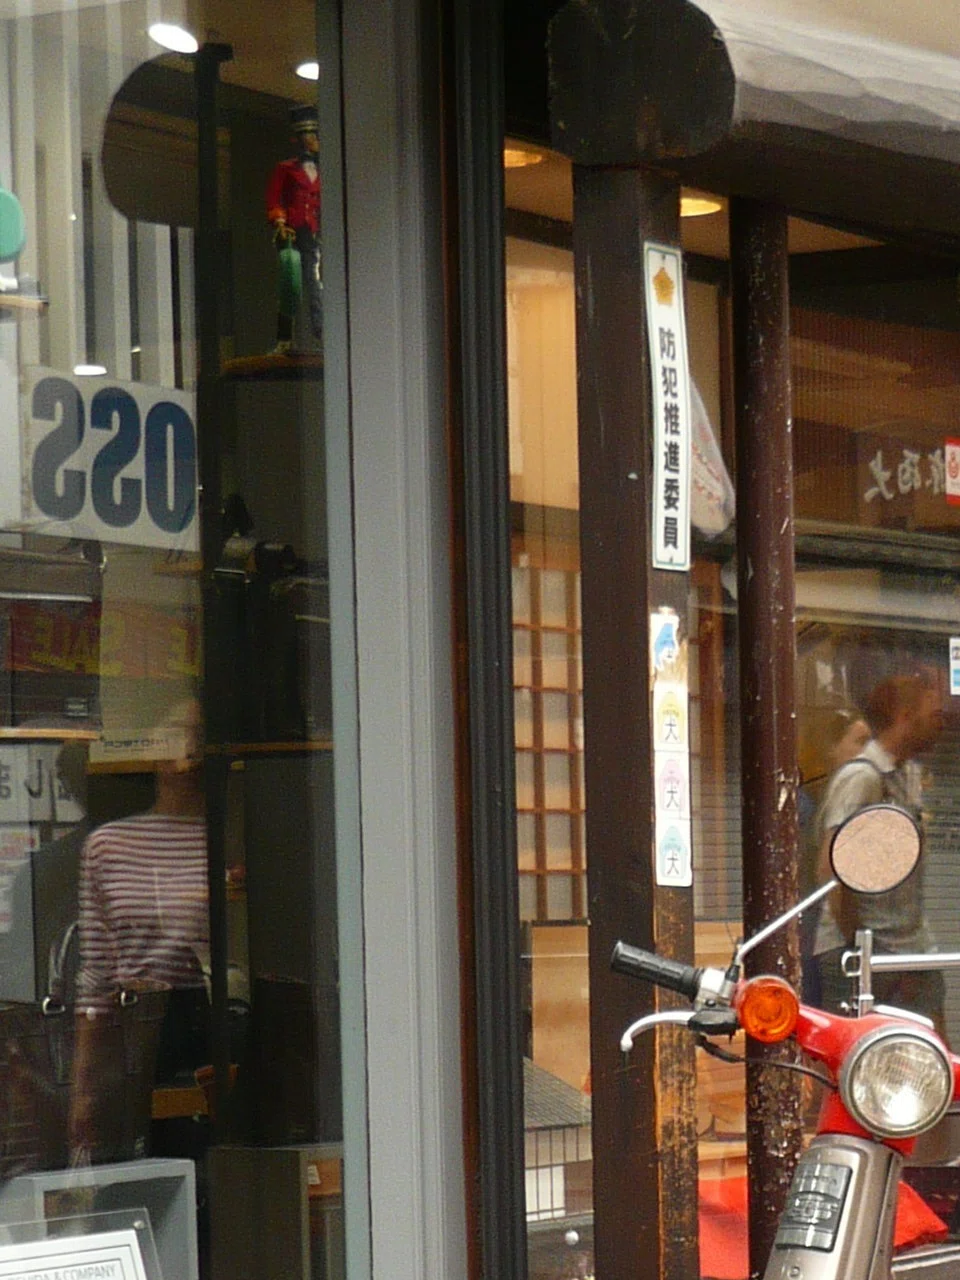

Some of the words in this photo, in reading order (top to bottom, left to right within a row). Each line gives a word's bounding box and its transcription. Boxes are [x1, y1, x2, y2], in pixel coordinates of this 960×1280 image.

[658, 326, 680, 550] 防犯推進委員
